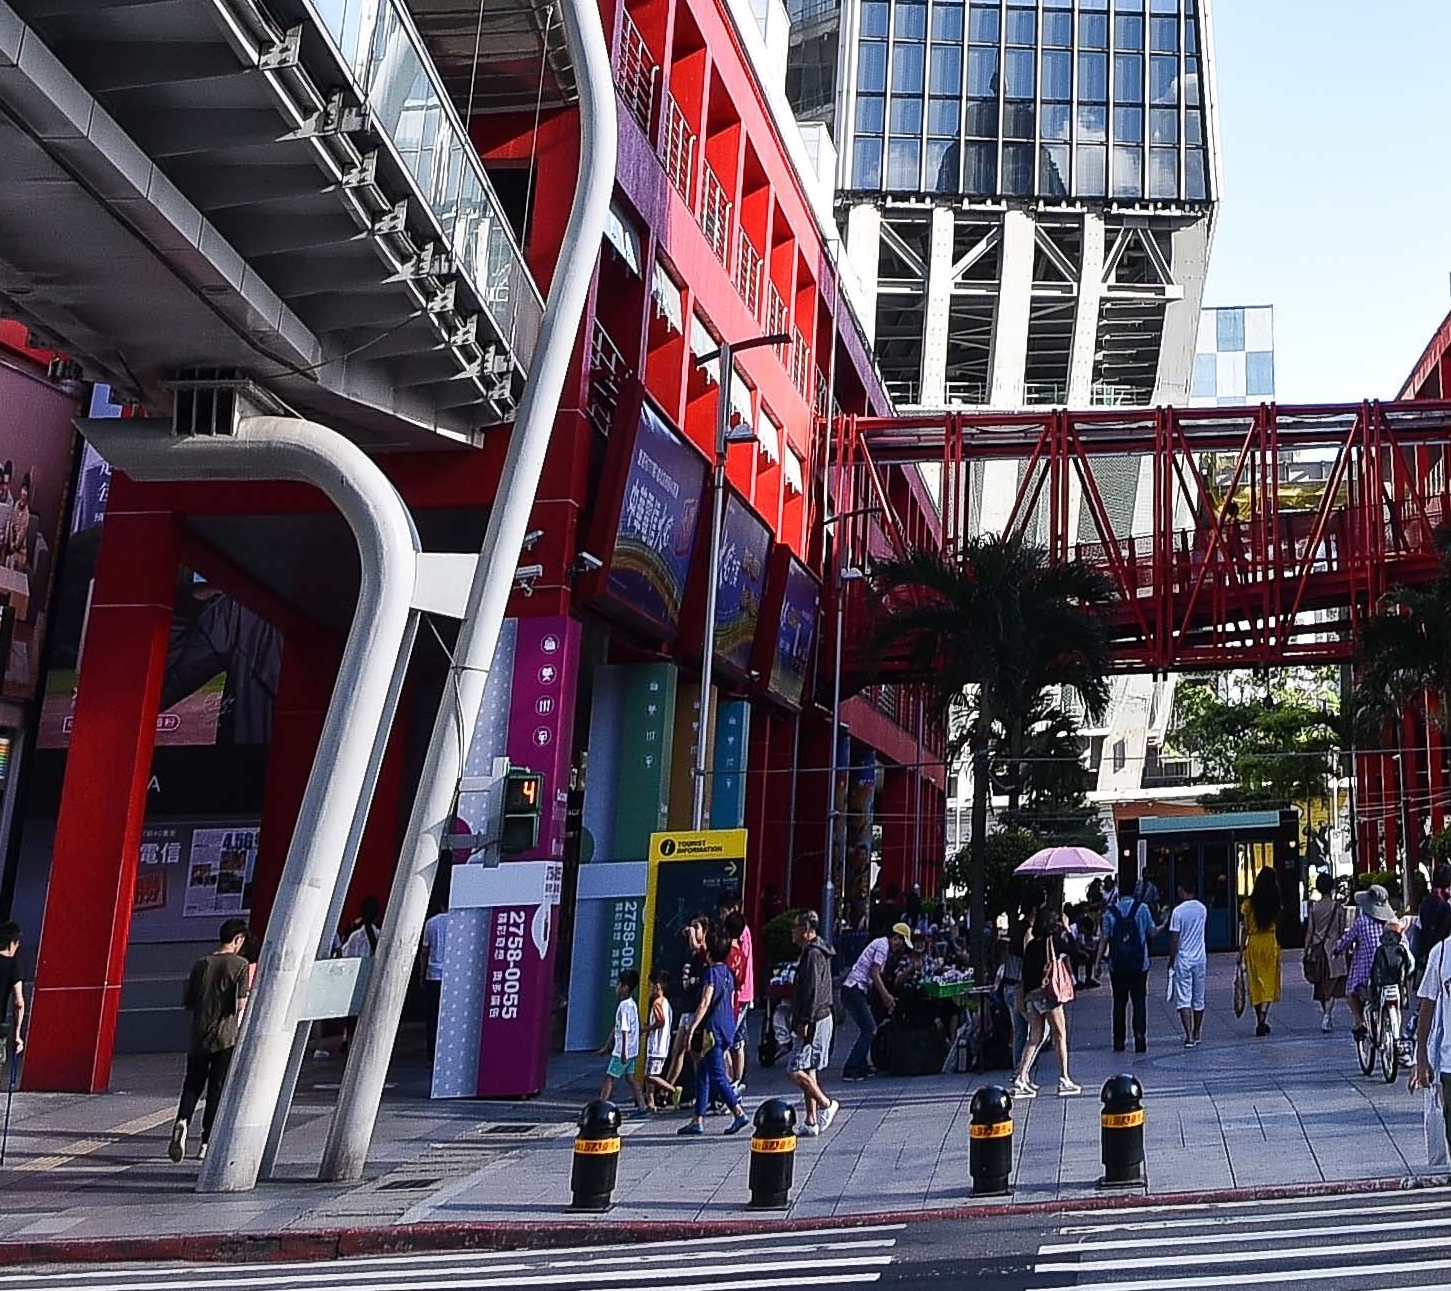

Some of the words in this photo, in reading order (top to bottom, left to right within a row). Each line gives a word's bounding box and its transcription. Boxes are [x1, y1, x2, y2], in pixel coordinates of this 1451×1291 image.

[523, 781, 535, 804] 4
[677, 839, 706, 848] TOURIST
[677, 845, 723, 854] INFORMATION
[621, 900, 637, 971] 2758-00
[501, 911, 525, 1019] 2758-0055
